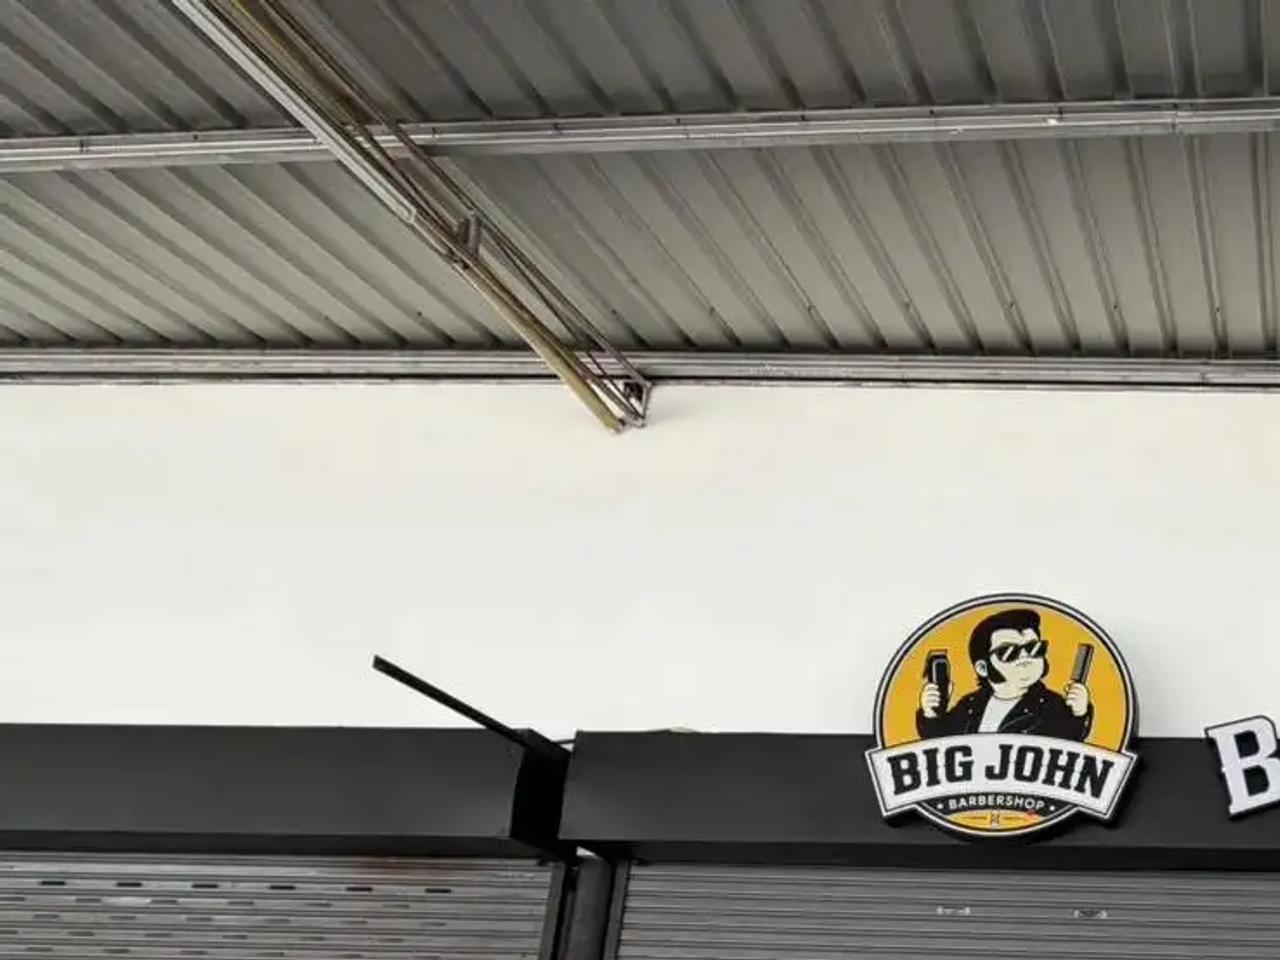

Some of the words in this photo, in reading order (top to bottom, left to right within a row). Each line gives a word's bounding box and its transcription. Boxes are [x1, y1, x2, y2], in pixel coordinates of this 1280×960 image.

[887, 745, 974, 795] BIG
[985, 744, 1113, 798] JOHN
[948, 795, 1045, 809] BARBERSHOP
